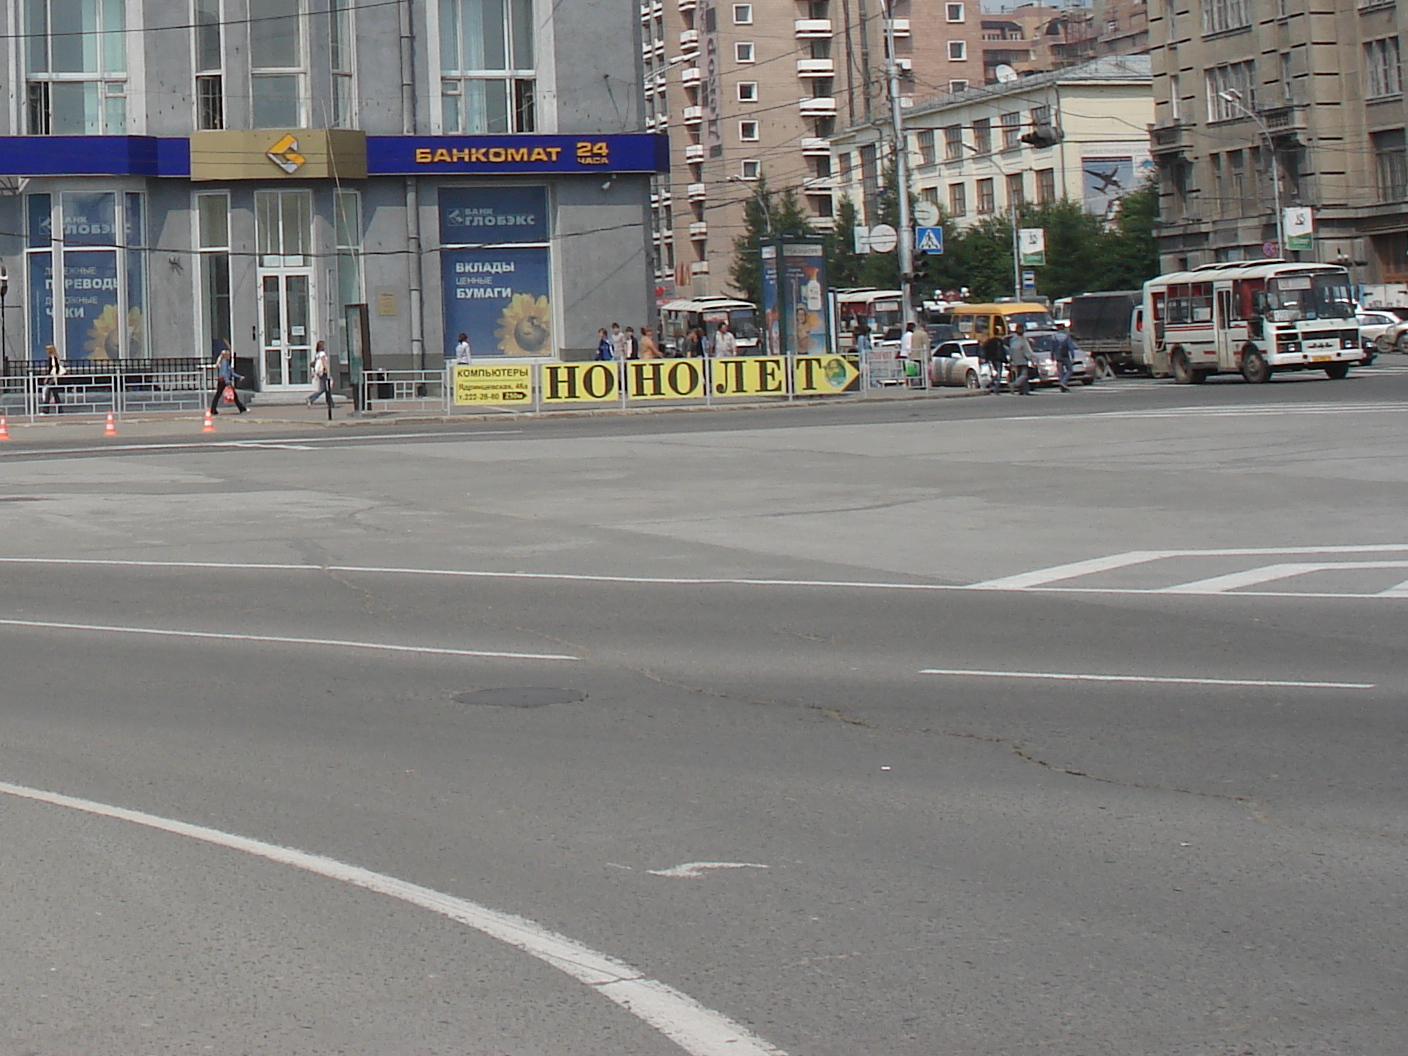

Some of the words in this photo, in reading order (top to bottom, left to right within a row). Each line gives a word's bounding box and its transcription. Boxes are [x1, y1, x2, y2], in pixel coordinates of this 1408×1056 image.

[415, 147, 562, 163] БАНКОМАТ
[576, 141, 609, 156] 24
[577, 157, 609, 165] ЧАСА
[465, 215, 535, 226] ГЛОБЭКС
[65, 224, 131, 235] ЛОБЭС
[455, 262, 515, 274] ВКЛАДЫ
[45, 278, 118, 290] ПРЕВОДЫ
[455, 277, 493, 286] ЦЕННЫЕ
[456, 288, 512, 299] БУМАГИ
[45, 307, 85, 318] ЧКИ
[457, 368, 529, 378] КОМПЬЮТЕРЫ
